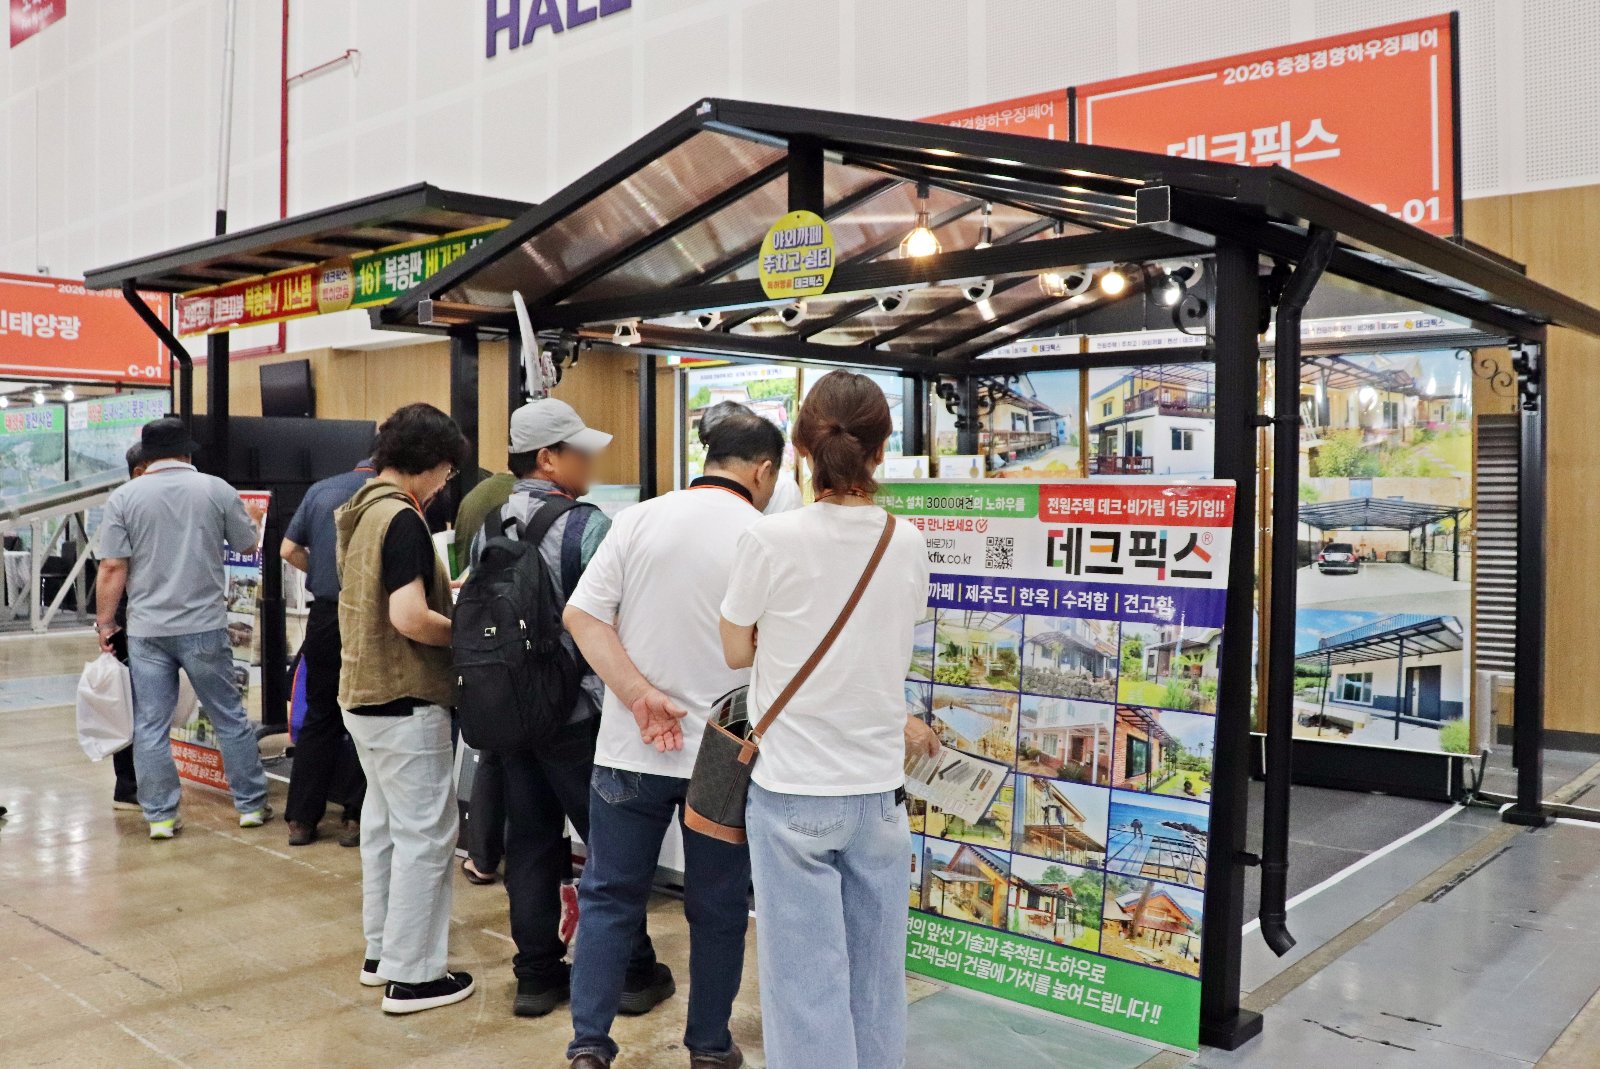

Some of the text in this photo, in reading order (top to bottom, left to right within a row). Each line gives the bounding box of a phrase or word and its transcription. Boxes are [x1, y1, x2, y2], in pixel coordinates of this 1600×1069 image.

[486, 0, 632, 58] HAL
[1223, 28, 1438, 86] 2026 충청경향하우징페어
[58, 284, 86, 295] 2026
[323, 268, 348, 284] 데크픽스
[359, 260, 383, 296] 16T
[385, 250, 422, 292] 복층판
[245, 282, 272, 317] 복층판
[283, 274, 312, 312] 시스템
[128, 364, 162, 378] C-01
[906, 496, 924, 510] 설치
[985, 497, 1025, 512] 노하우를
[1047, 497, 1095, 515] 전원주택
[1169, 499, 1225, 518] 1등기업!!
[927, 518, 974, 532] 만나보세요
[926, 538, 956, 550] 바로가기
[1046, 526, 1213, 581] 데크픽스
[965, 584, 1009, 605] 제주도
[1019, 588, 1050, 608] 한옥
[1061, 590, 1109, 612] 수려함
[1124, 593, 1174, 617] 견고함
[927, 922, 955, 946] 앞선
[955, 929, 999, 957] 기술과
[1043, 952, 1107, 985] 노하우로
[907, 940, 963, 971] 고객님의
[963, 955, 1007, 984] 건물에
[1006, 967, 1052, 996] 가치를
[1051, 978, 1085, 1005] 높여
